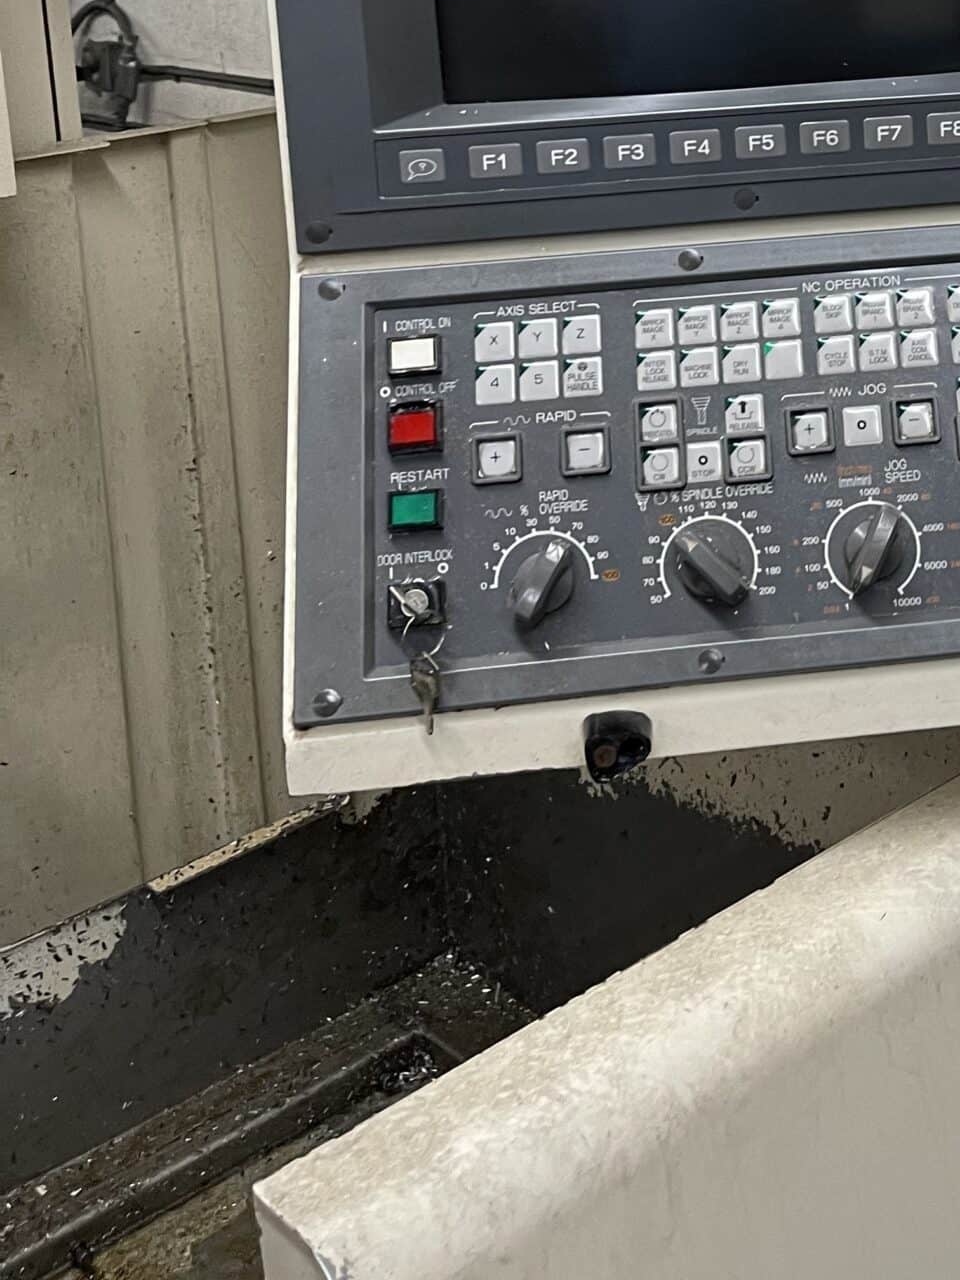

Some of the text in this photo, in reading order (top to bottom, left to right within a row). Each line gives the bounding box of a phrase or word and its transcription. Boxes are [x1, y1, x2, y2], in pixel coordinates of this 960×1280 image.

[813, 129, 839, 147] F6
[877, 125, 902, 142] F7
[683, 139, 711, 157] F4
[749, 134, 774, 151] F5
[551, 148, 578, 166] F2
[617, 144, 644, 161] F3
[482, 153, 507, 171] F1
[802, 275, 901, 293] NC OPERATION
[496, 300, 577, 317] AXIS SELECT
[395, 317, 451, 331] CONTROL ON
[533, 331, 541, 342] Y
[576, 328, 585, 339] Z
[490, 335, 498, 346] X
[490, 377, 499, 388] 4
[534, 374, 543, 385] 5
[395, 383, 436, 397] CONTROL
[858, 383, 887, 396] JOG
[535, 411, 576, 424] RAPID
[884, 459, 908, 472] JOG
[390, 468, 450, 484] RESTART
[885, 470, 921, 484] SPEED
[538, 489, 569, 502] RAPID
[682, 482, 774, 501] SPINDLE OVERRIDE
[859, 487, 880, 497] 1000
[897, 493, 918, 503] 2000
[539, 500, 588, 515] OVERRIDE
[679, 504, 695, 513] 110
[700, 500, 717, 509] 120
[721, 501, 738, 510] 130
[741, 510, 757, 519] 140
[505, 527, 516, 536] 10
[572, 522, 583, 530] 70
[922, 523, 944, 532] 4000
[802, 536, 819, 546] 200
[377, 549, 453, 567] DOOR INTERLOCK
[805, 563, 821, 573] 100
[480, 582, 488, 590] 0
[643, 578, 655, 586] 70
[759, 586, 776, 595] 200
[893, 596, 922, 607] 10000
